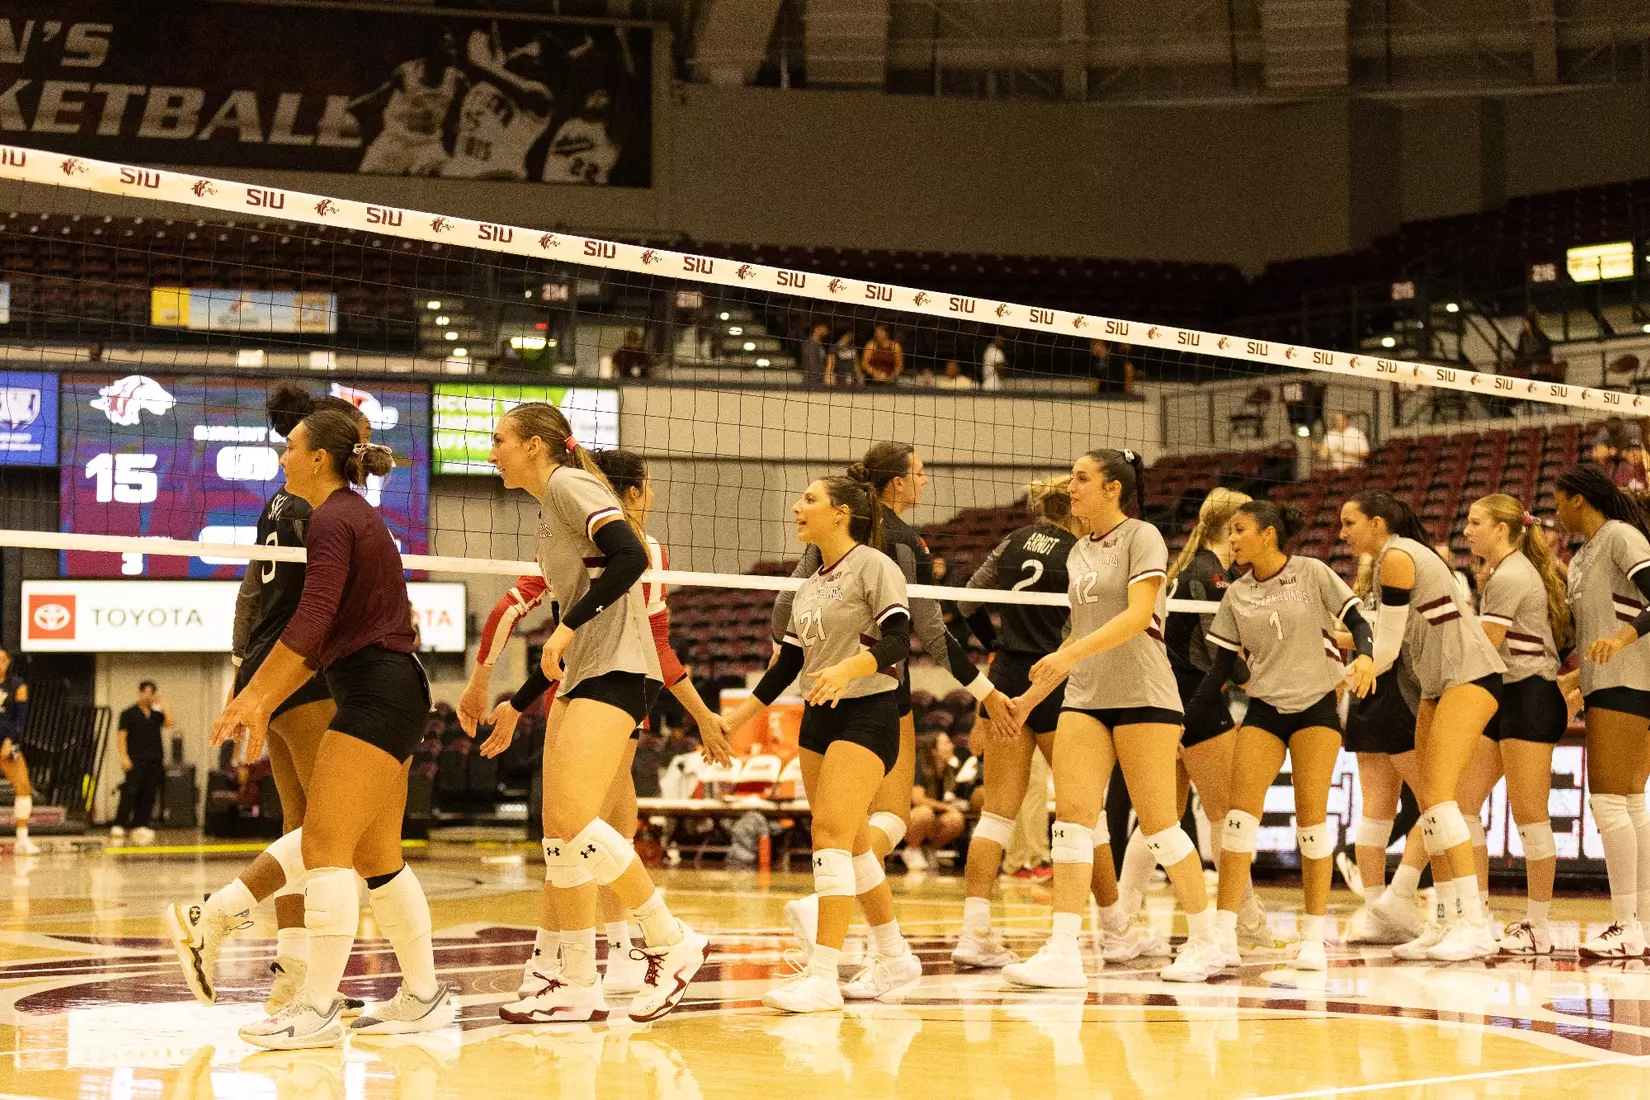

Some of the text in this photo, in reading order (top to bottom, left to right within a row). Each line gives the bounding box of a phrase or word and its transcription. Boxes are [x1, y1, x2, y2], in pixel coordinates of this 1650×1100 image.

[120, 168, 160, 188] SIU
[246, 189, 284, 209] SIU
[367, 207, 402, 226] SIU
[478, 225, 512, 243] SIU
[584, 241, 616, 259] SIU
[683, 257, 713, 274] SIU
[777, 271, 805, 288] SIU
[865, 285, 892, 301] SIU
[949, 298, 975, 313] SIU
[1030, 309, 1054, 324] SIU
[1106, 321, 1128, 335] SIU
[1178, 332, 1199, 346] SIU
[1247, 342, 1268, 356] SIU
[1313, 352, 1333, 365] SIU
[1377, 361, 1397, 373] SIU
[1437, 370, 1455, 382] SIU
[1495, 378, 1513, 390] SIU
[1550, 386, 1567, 397] SIU
[1604, 393, 1620, 404] SIU
[85, 452, 158, 503] 15
[1011, 559, 1044, 592] 2
[1073, 571, 1099, 605] 12
[91, 609, 203, 627] TOYOTA
[799, 605, 827, 648] 21
[1268, 610, 1284, 641] 1
